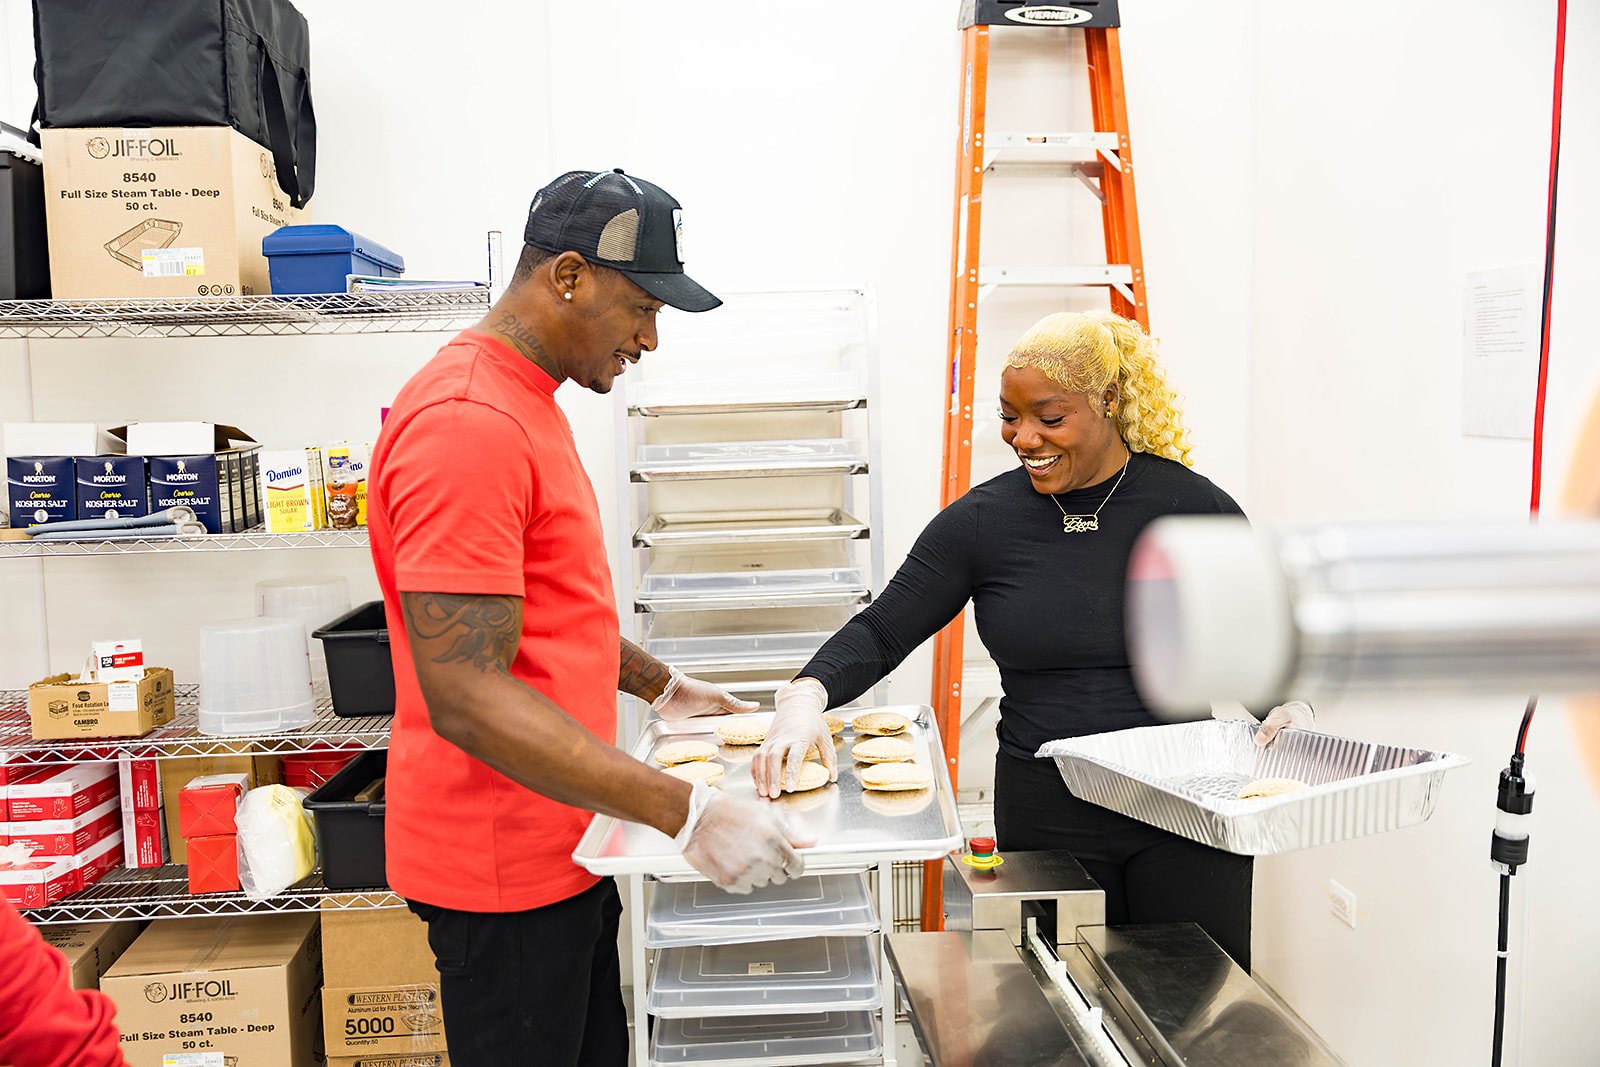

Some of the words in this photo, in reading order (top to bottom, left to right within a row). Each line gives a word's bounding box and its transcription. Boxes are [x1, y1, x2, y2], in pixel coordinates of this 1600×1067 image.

[1024, 10, 1075, 20] WERNER
[122, 172, 157, 183] 8540
[60, 190, 81, 199] Full
[84, 189, 108, 199] Size
[111, 189, 148, 198] Steam
[150, 188, 182, 198] Table
[191, 188, 221, 198] Deep
[125, 202, 140, 211] 50
[142, 201, 158, 211] ct.
[23, 475, 56, 483] MORTON
[93, 475, 127, 483] MORTON
[166, 473, 199, 482] MORTON
[266, 466, 302, 482] Domino
[29, 490, 52, 500] Coarse
[100, 490, 122, 500] Coarse
[173, 489, 195, 498] Coarse
[15, 500, 48, 508] KOSHER
[48, 500, 68, 508] SALT
[85, 500, 118, 508] KOSHER
[118, 499, 138, 508] SALT
[158, 498, 191, 507] KOSHER
[190, 497, 211, 506] SALT
[266, 500, 285, 509] LIGHT
[286, 498, 310, 508] BROWN
[279, 507, 298, 515] SUGAR
[102, 657, 113, 665] 250
[73, 718, 99, 726] CAMBRO
[356, 994, 391, 1004] WESTERN
[392, 991, 430, 1002] PLASTICS
[179, 1012, 213, 1024] 8540
[345, 1017, 394, 1035] 5000
[119, 1033, 139, 1042] Full
[142, 1031, 165, 1041] Size
[168, 1028, 204, 1039] Steam
[207, 1025, 238, 1036] Table
[247, 1023, 275, 1033] Deep
[182, 1040, 196, 1050] 50
[199, 1039, 214, 1049] ct.
